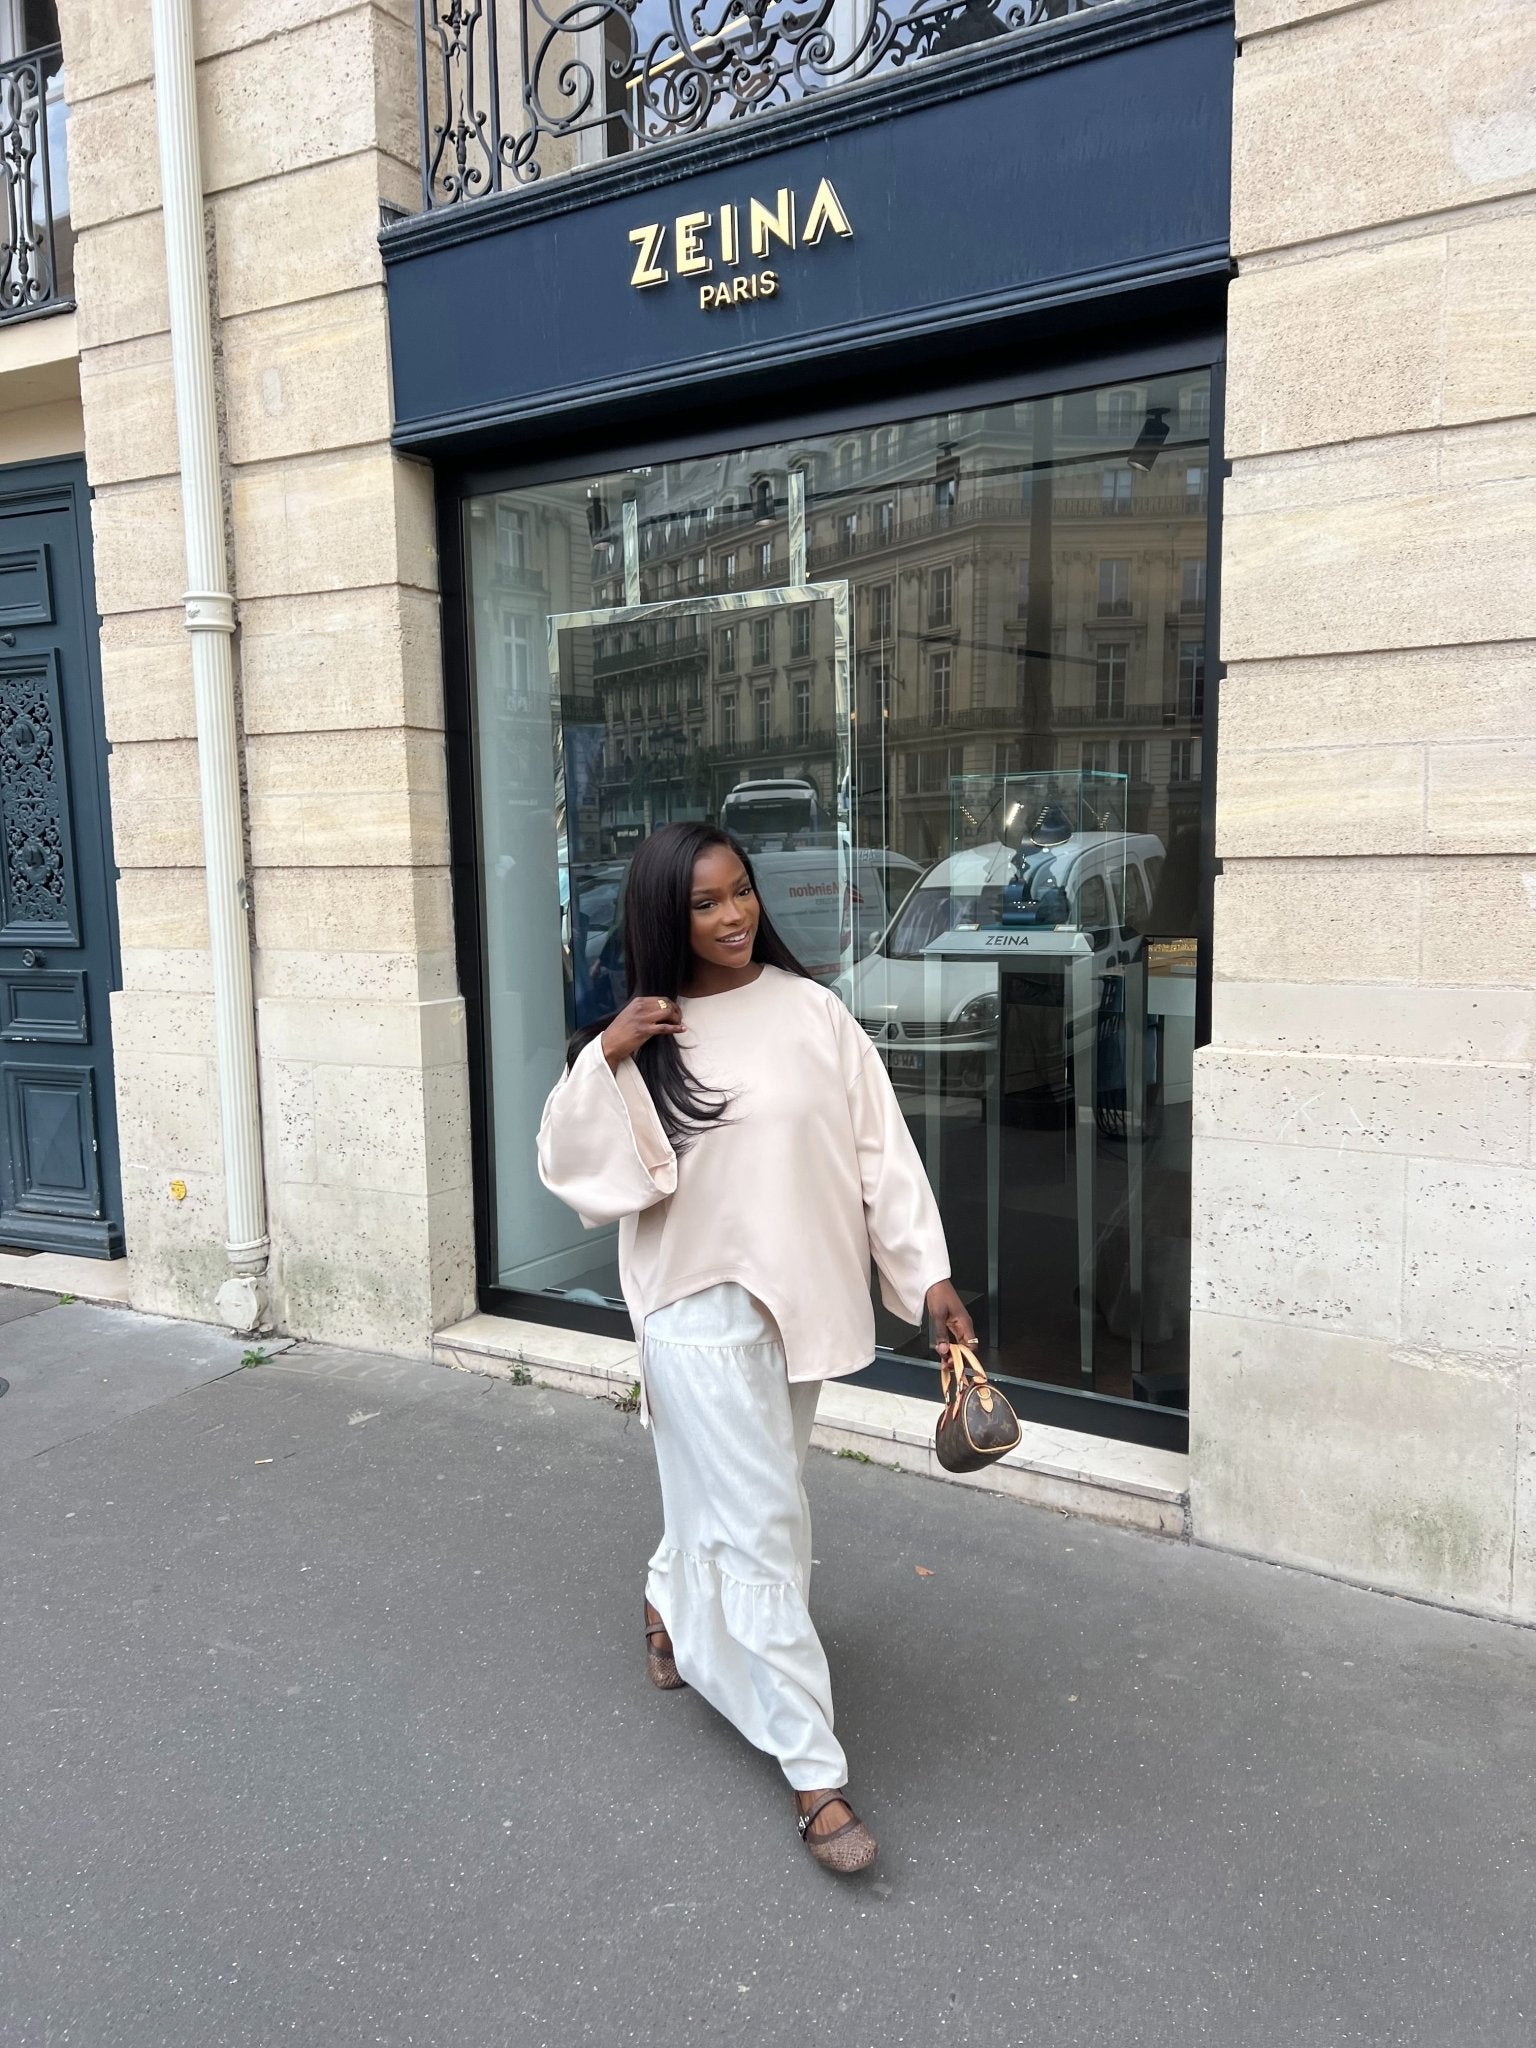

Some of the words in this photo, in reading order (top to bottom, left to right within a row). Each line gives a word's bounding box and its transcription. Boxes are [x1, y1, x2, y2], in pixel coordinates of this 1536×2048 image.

[629, 177, 853, 288] ZEINA
[700, 271, 777, 310] PARIS
[985, 935, 1029, 946] ZEINA
